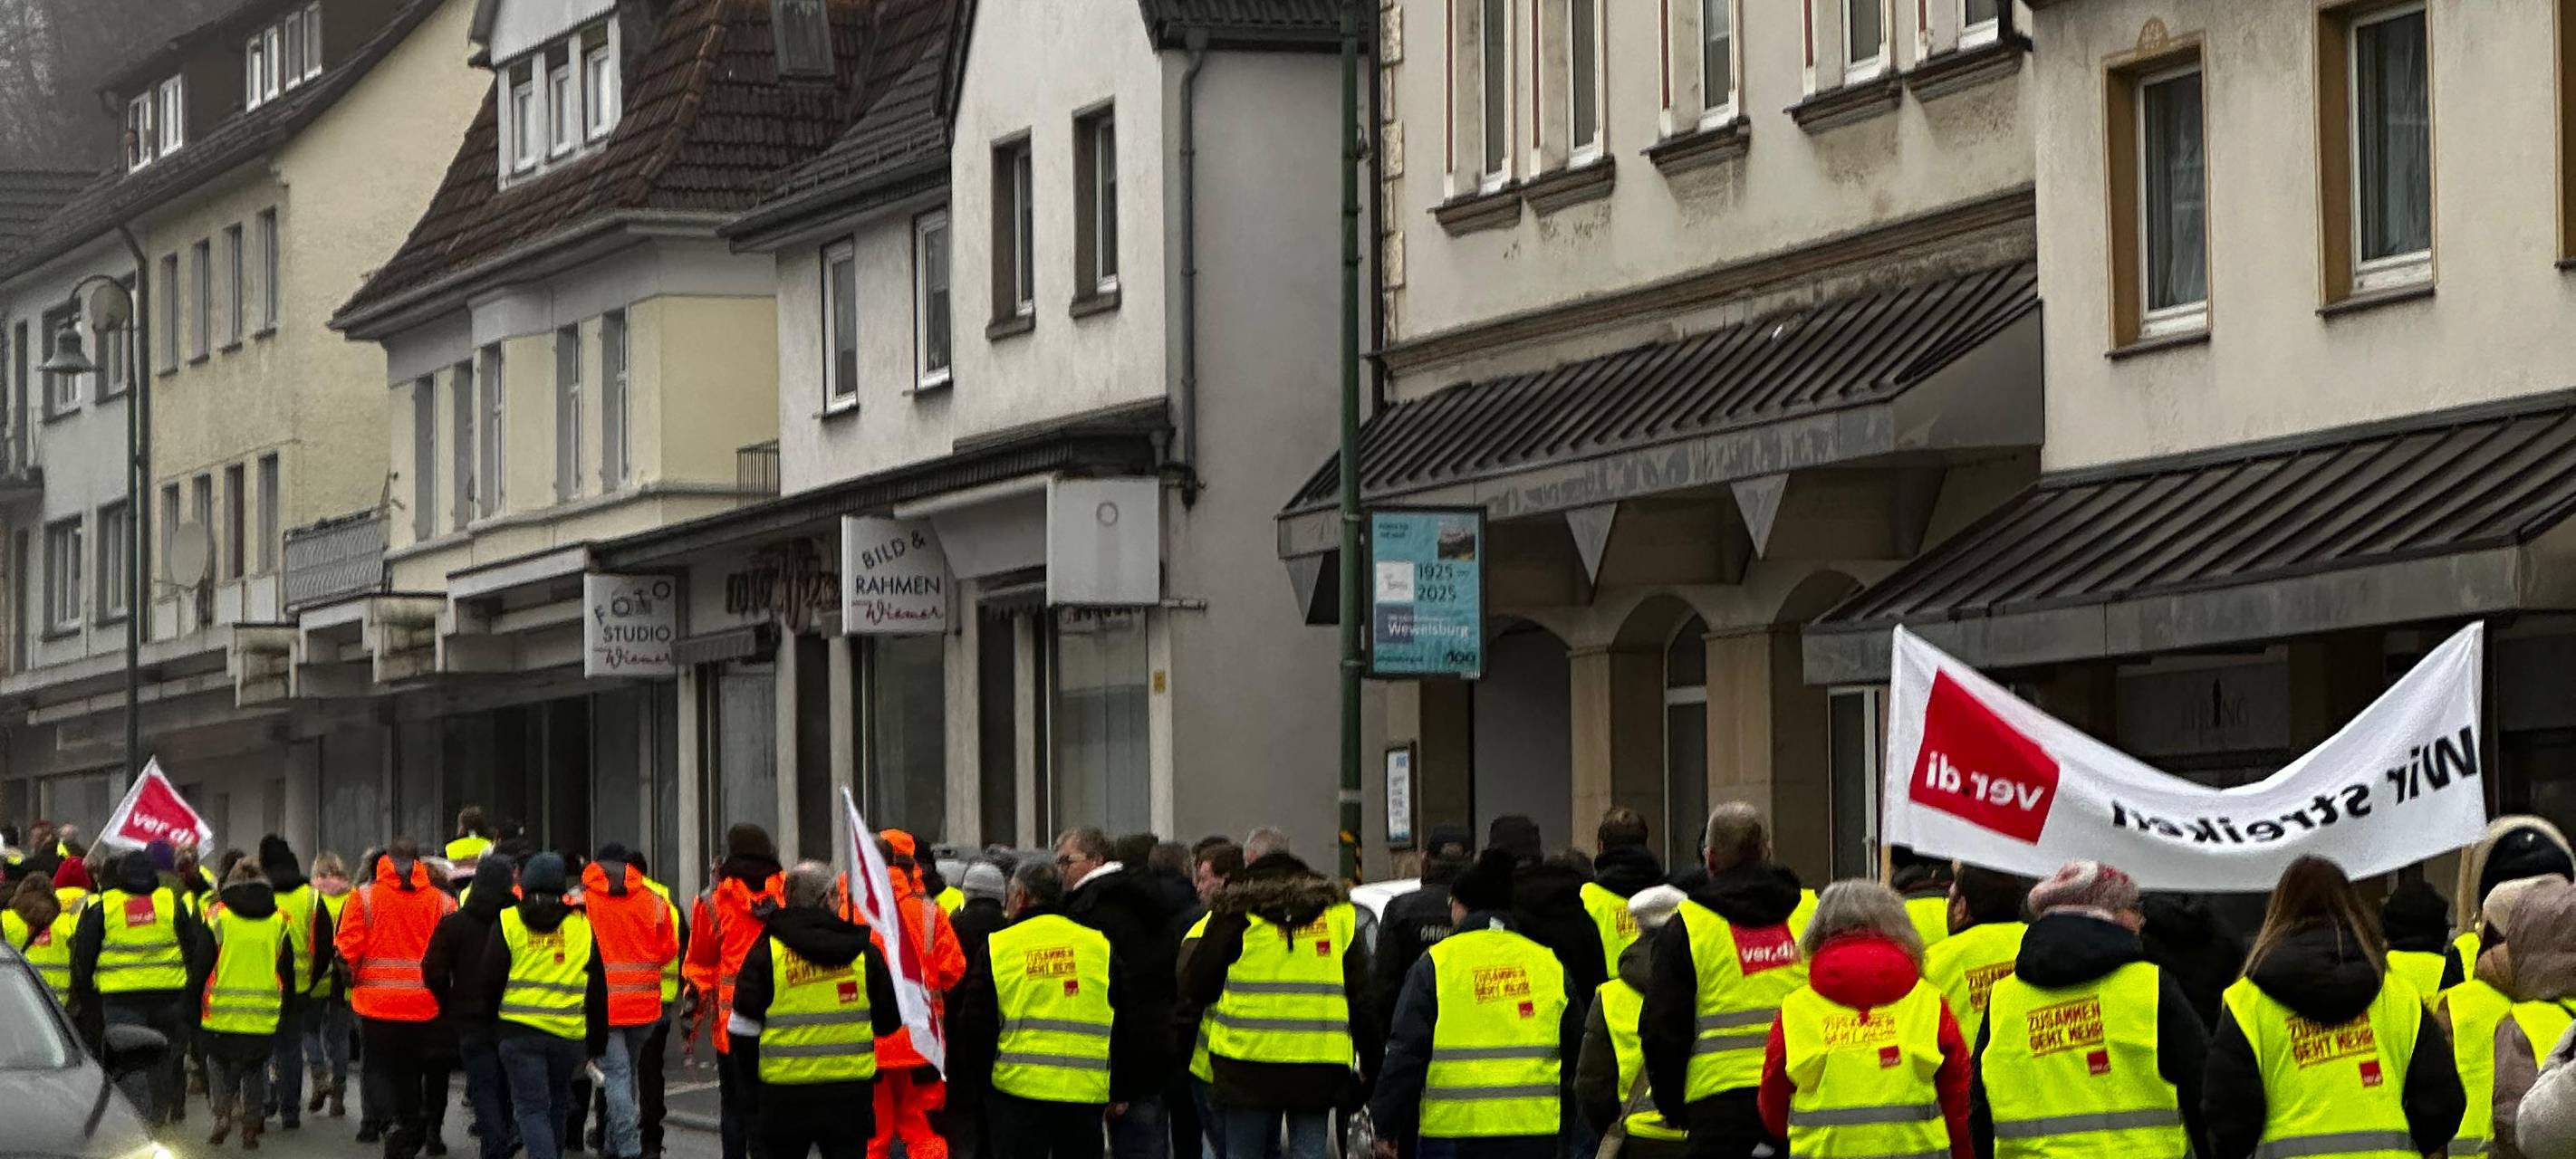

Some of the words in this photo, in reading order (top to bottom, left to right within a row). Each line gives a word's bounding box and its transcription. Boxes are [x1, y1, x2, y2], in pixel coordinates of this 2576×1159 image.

[861, 537, 906, 570] BILD
[911, 530, 926, 550] &
[1418, 563, 1453, 581] 1925
[856, 575, 940, 595] RAHMEN
[1418, 584, 1456, 603] 2025
[594, 580, 670, 626] FOTO
[851, 599, 943, 626] Wiemer
[602, 625, 670, 643] STUDIO
[1388, 622, 1468, 638] Wewelsburg
[1741, 940, 1794, 963] ver.di
[2028, 1000, 2101, 1032] ZUSAMMEN
[2030, 1029, 2062, 1051] GEHT
[2069, 1021, 2103, 1043] MEHR
[2293, 1038, 2330, 1062] GEHT
[2338, 1028, 2375, 1053] MEHR
